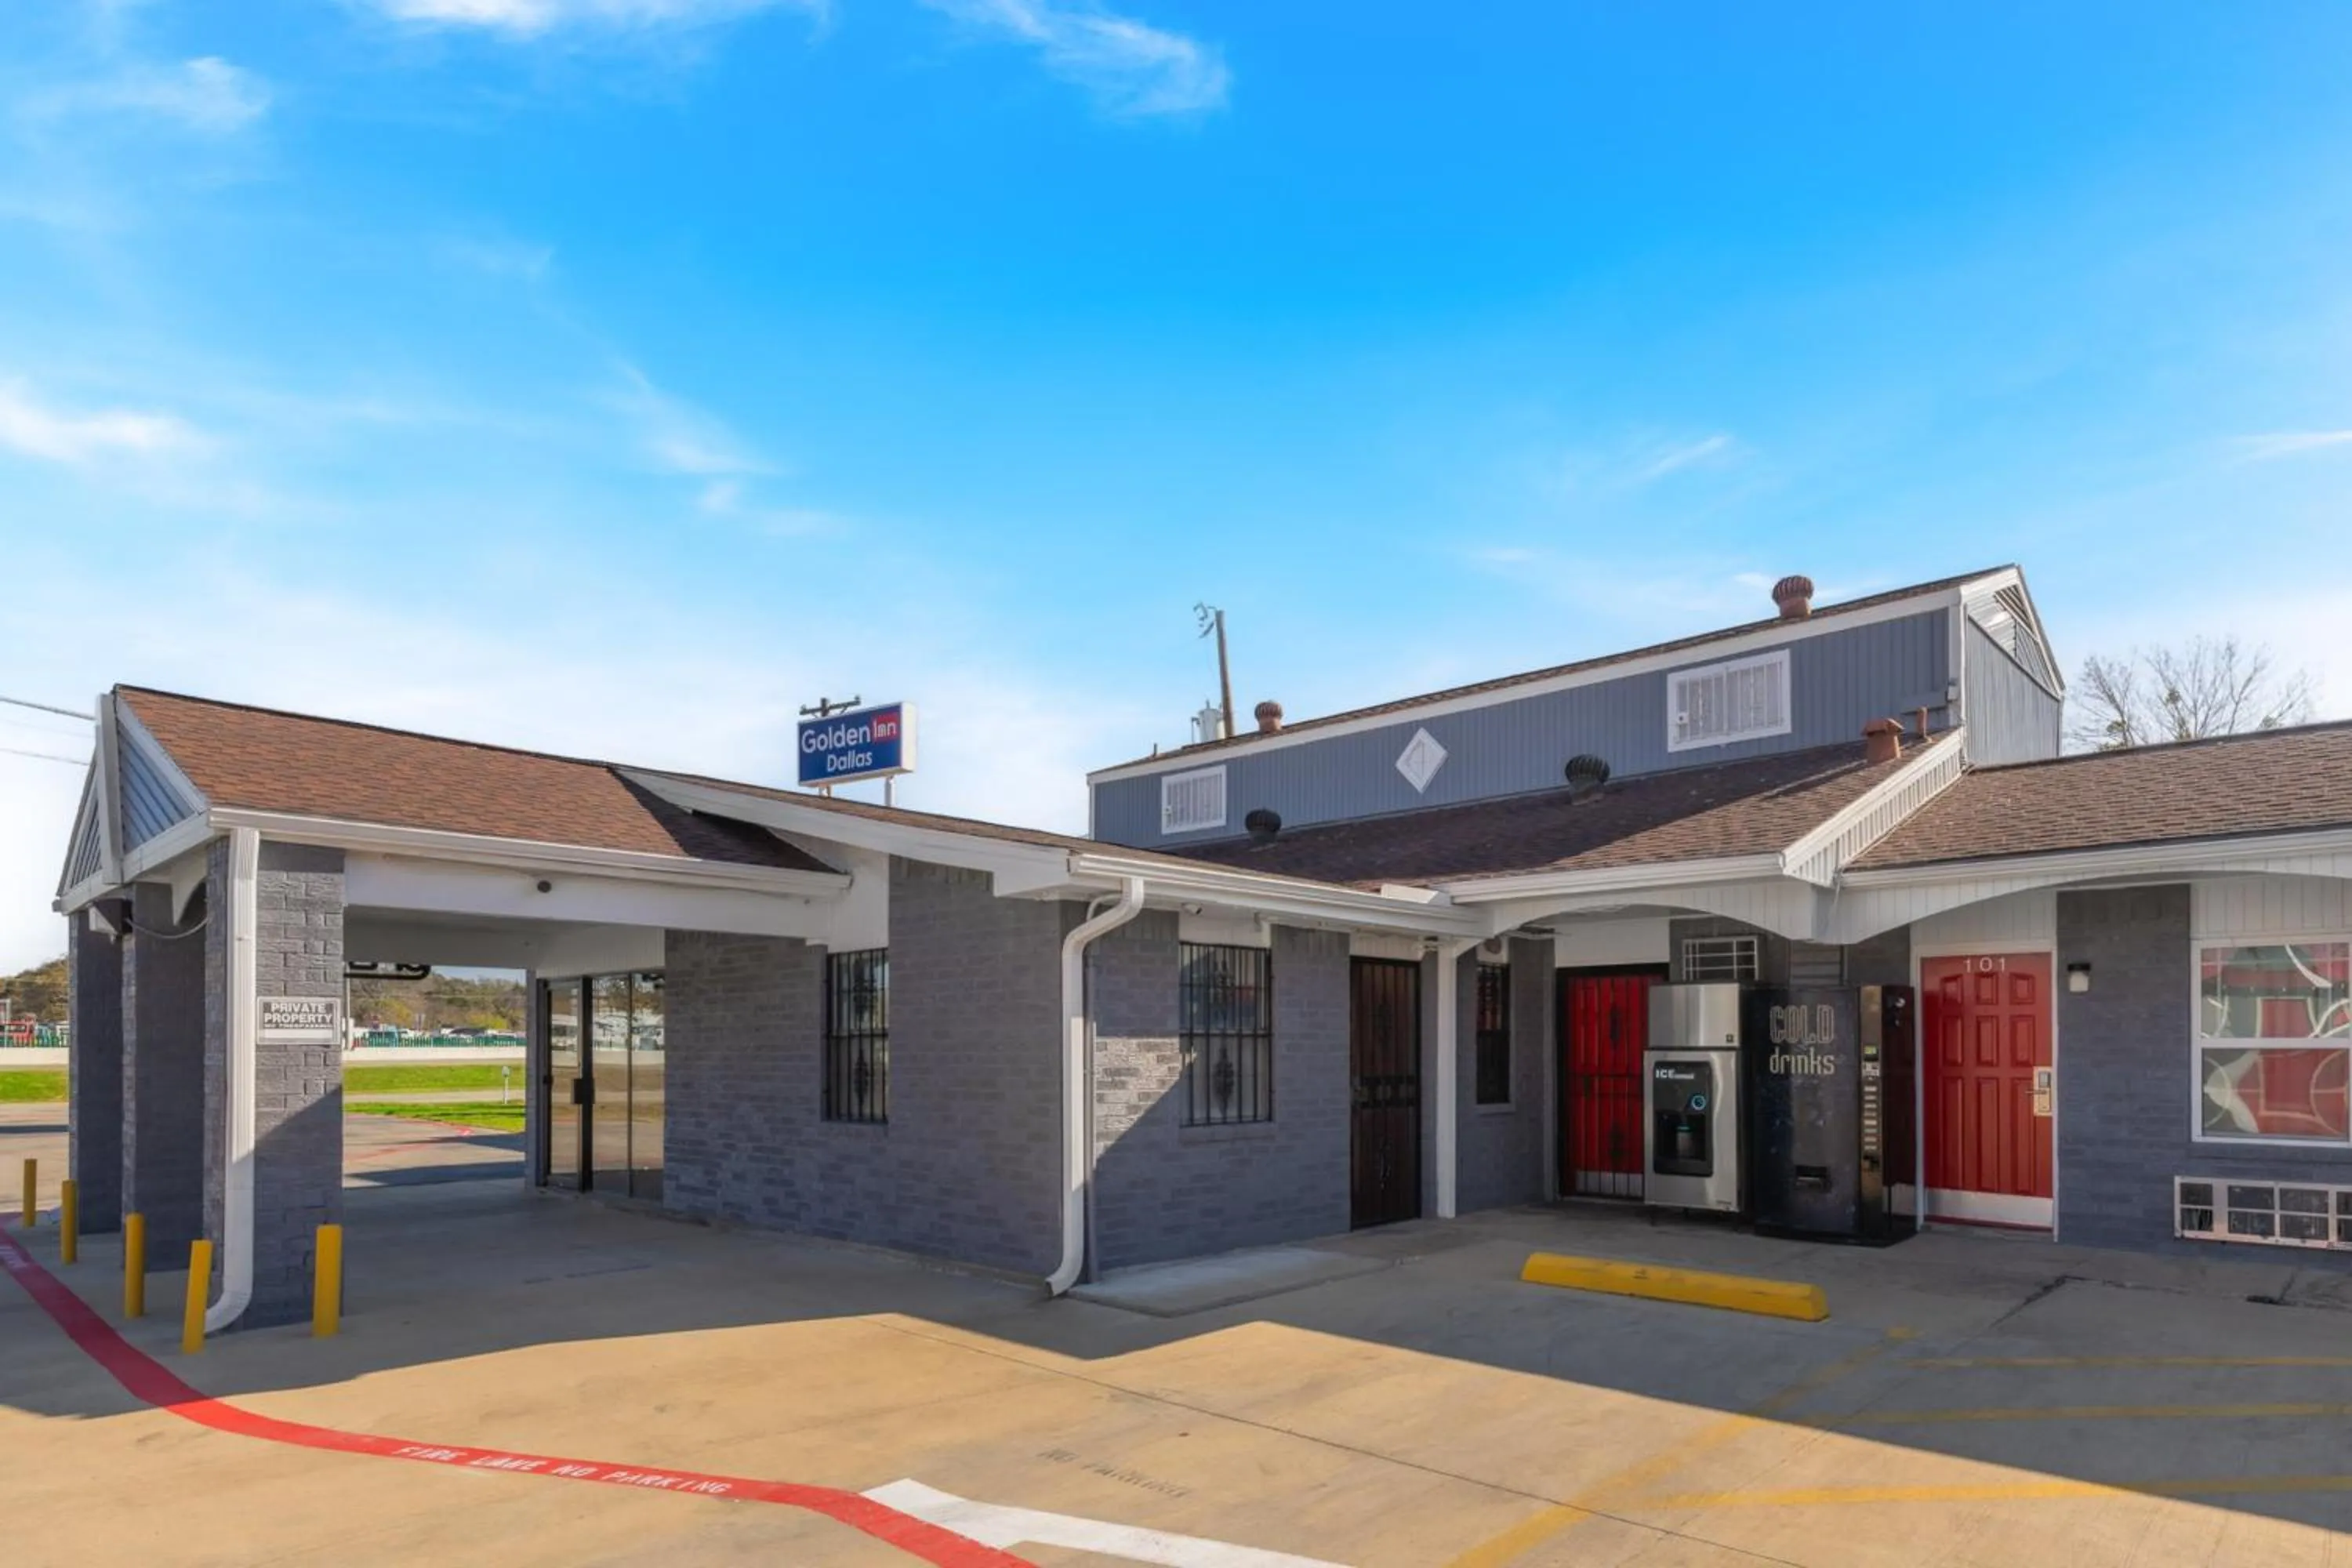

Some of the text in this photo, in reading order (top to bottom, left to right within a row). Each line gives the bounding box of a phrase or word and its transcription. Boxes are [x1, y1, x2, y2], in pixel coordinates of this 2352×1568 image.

[801, 719, 897, 753] Golden Inn
[827, 750, 873, 772] Dallas
[1964, 956, 2005, 973] 101
[264, 1013, 333, 1023] PROPERTY
[270, 1003, 327, 1013] PRIVATE
[1769, 1004, 1835, 1044] COLD
[1769, 1045, 1835, 1076] drinks
[1655, 1069, 1675, 1079] ICE
[392, 1446, 733, 1494] FIRE LANE NO PARKING
